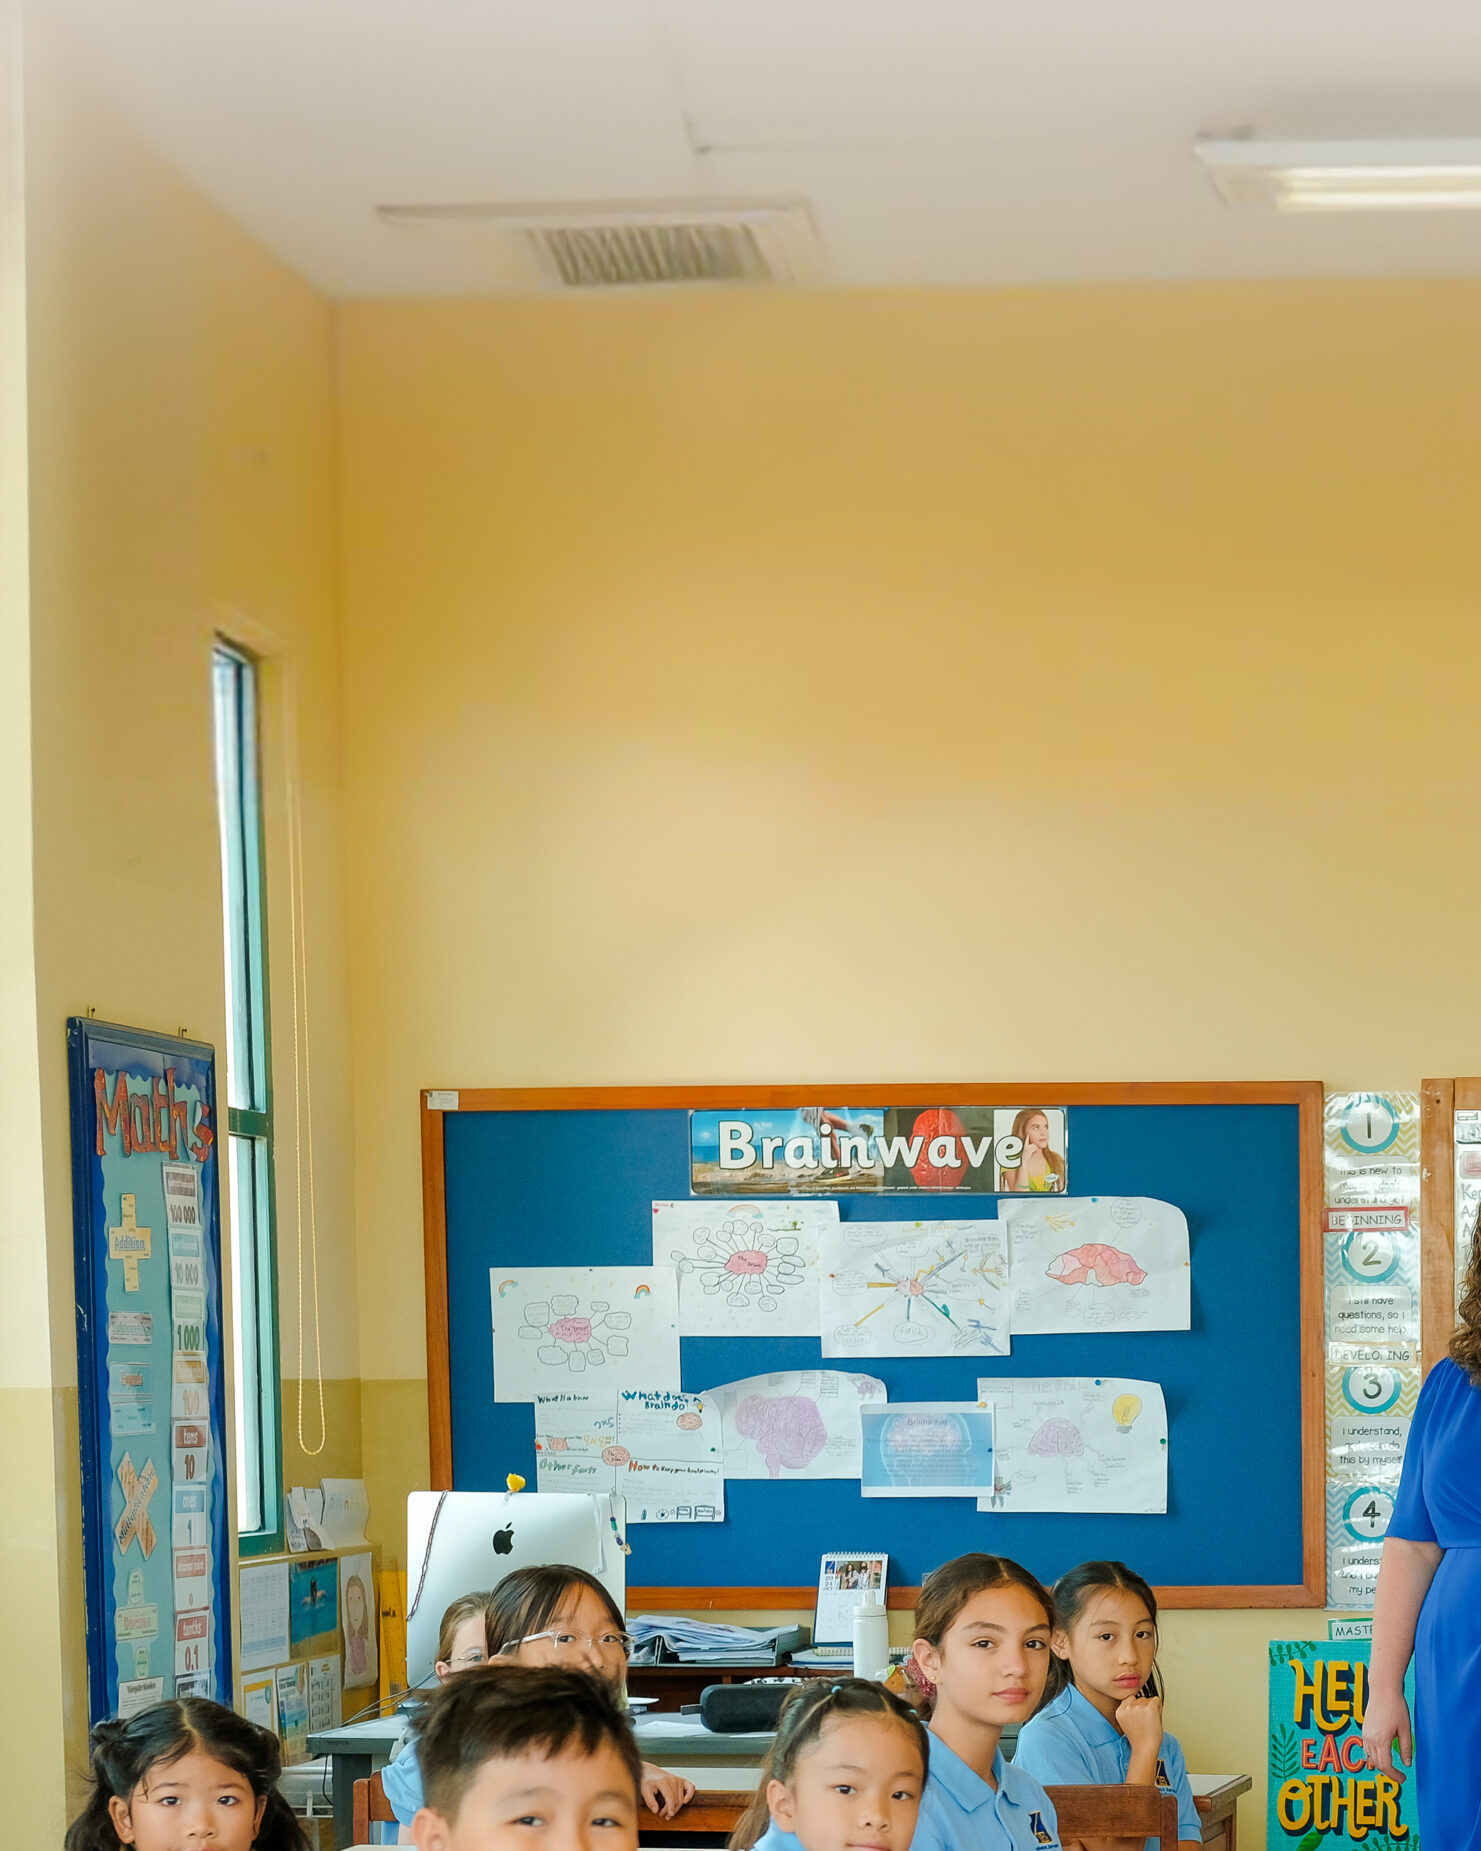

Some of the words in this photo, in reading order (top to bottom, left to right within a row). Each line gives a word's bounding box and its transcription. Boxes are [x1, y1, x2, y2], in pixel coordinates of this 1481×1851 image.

[94, 1067, 214, 1163] Maths
[718, 1120, 1025, 1171] Brainwave
[1369, 1167, 1388, 1175] new
[1392, 1166, 1402, 1175] to
[1331, 1214, 1401, 1226] BEINNING
[114, 1235, 146, 1252] Addition
[1361, 1240, 1382, 1266] 2
[1371, 1297, 1394, 1305] have
[1338, 1310, 1385, 1320] questions,
[1359, 1325, 1385, 1334] some
[1362, 1372, 1382, 1399] 3
[907, 1417, 947, 1426] Brainwave
[183, 1428, 198, 1445] tens
[1347, 1426, 1402, 1437] understand,
[184, 1454, 195, 1480] 10
[1340, 1455, 1356, 1464] this
[1358, 1455, 1370, 1466] by
[1362, 1500, 1381, 1528] 4
[1349, 1556, 1381, 1566] unders
[1349, 1585, 1363, 1595] my
[183, 1621, 202, 1637] tenths
[185, 1644, 199, 1672] 0.1
[1277, 1774, 1408, 1838] OTHER
